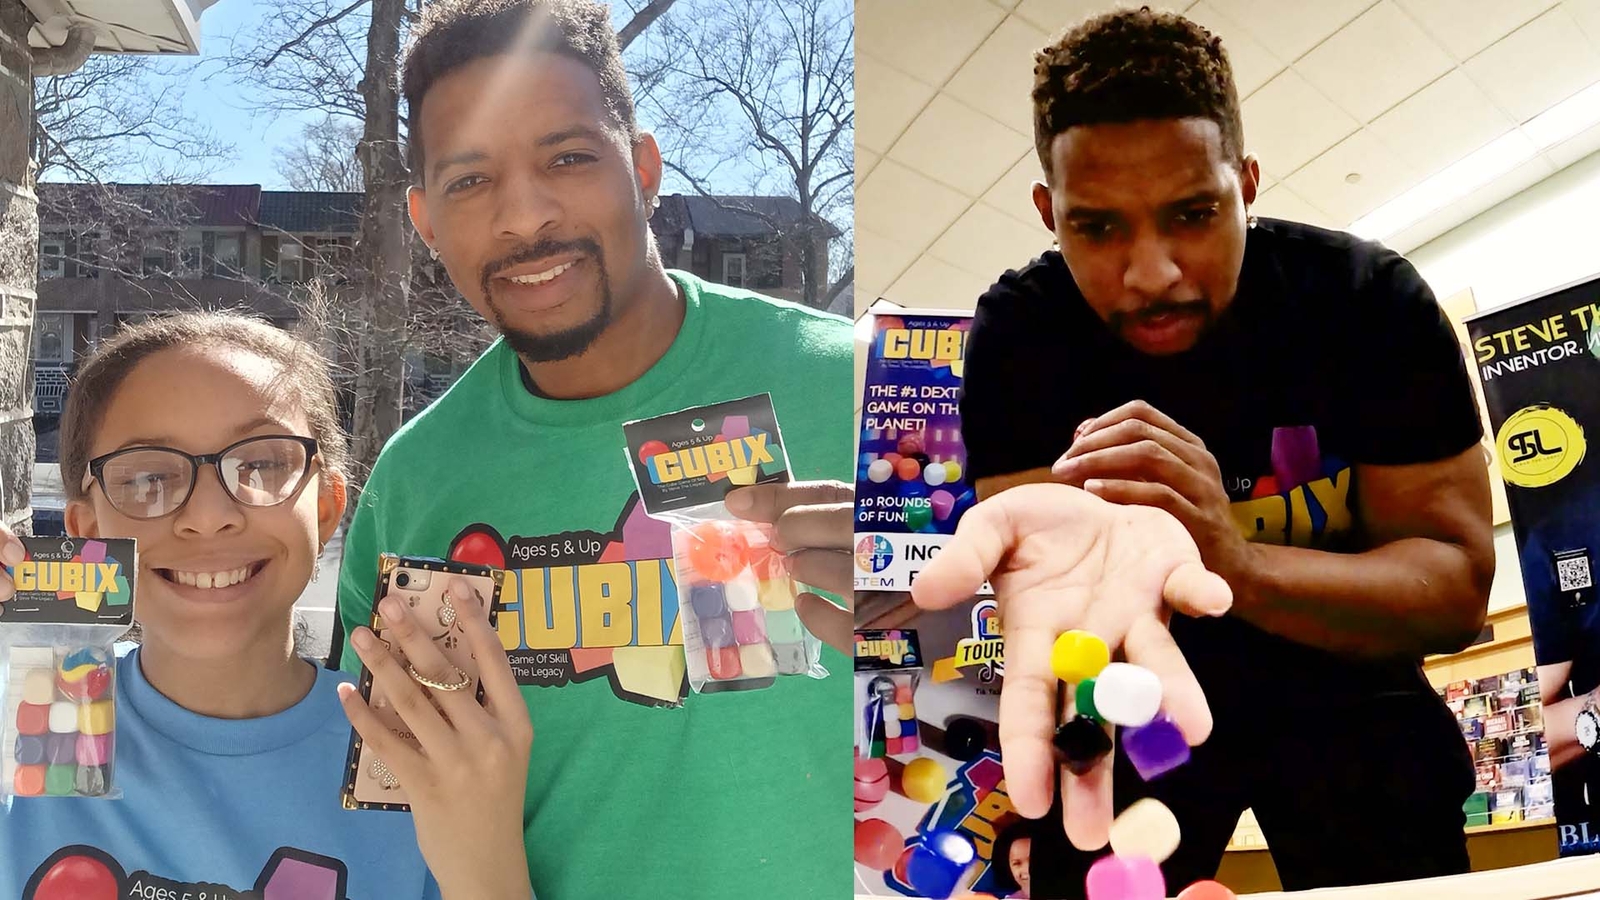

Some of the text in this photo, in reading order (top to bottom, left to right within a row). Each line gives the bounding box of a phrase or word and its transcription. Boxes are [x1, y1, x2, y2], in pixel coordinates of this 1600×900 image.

[884, 329, 968, 360] CUB
[1474, 314, 1569, 363] STEVE
[1482, 340, 1583, 382] INVENTOR,
[869, 385, 897, 397] THE
[900, 386, 917, 397] #1
[867, 401, 909, 414] GAME
[912, 402, 936, 414] ON
[865, 418, 927, 431] PLANET!
[671, 441, 690, 449] Ages
[702, 434, 714, 444] Up
[654, 433, 774, 483] CUBIX
[1227, 476, 1252, 492] Up
[860, 497, 931, 508] 10 ROUNDS
[859, 511, 908, 522] OF FUN!
[62, 551, 73, 559] Up
[512, 539, 601, 560] Ages 5 & Up
[15, 561, 119, 593] CUBIX
[857, 639, 909, 657] CUBIX
[507, 653, 568, 665] Game Of Skill
[512, 667, 564, 678] The Legacy
[129, 880, 177, 900] Ages
